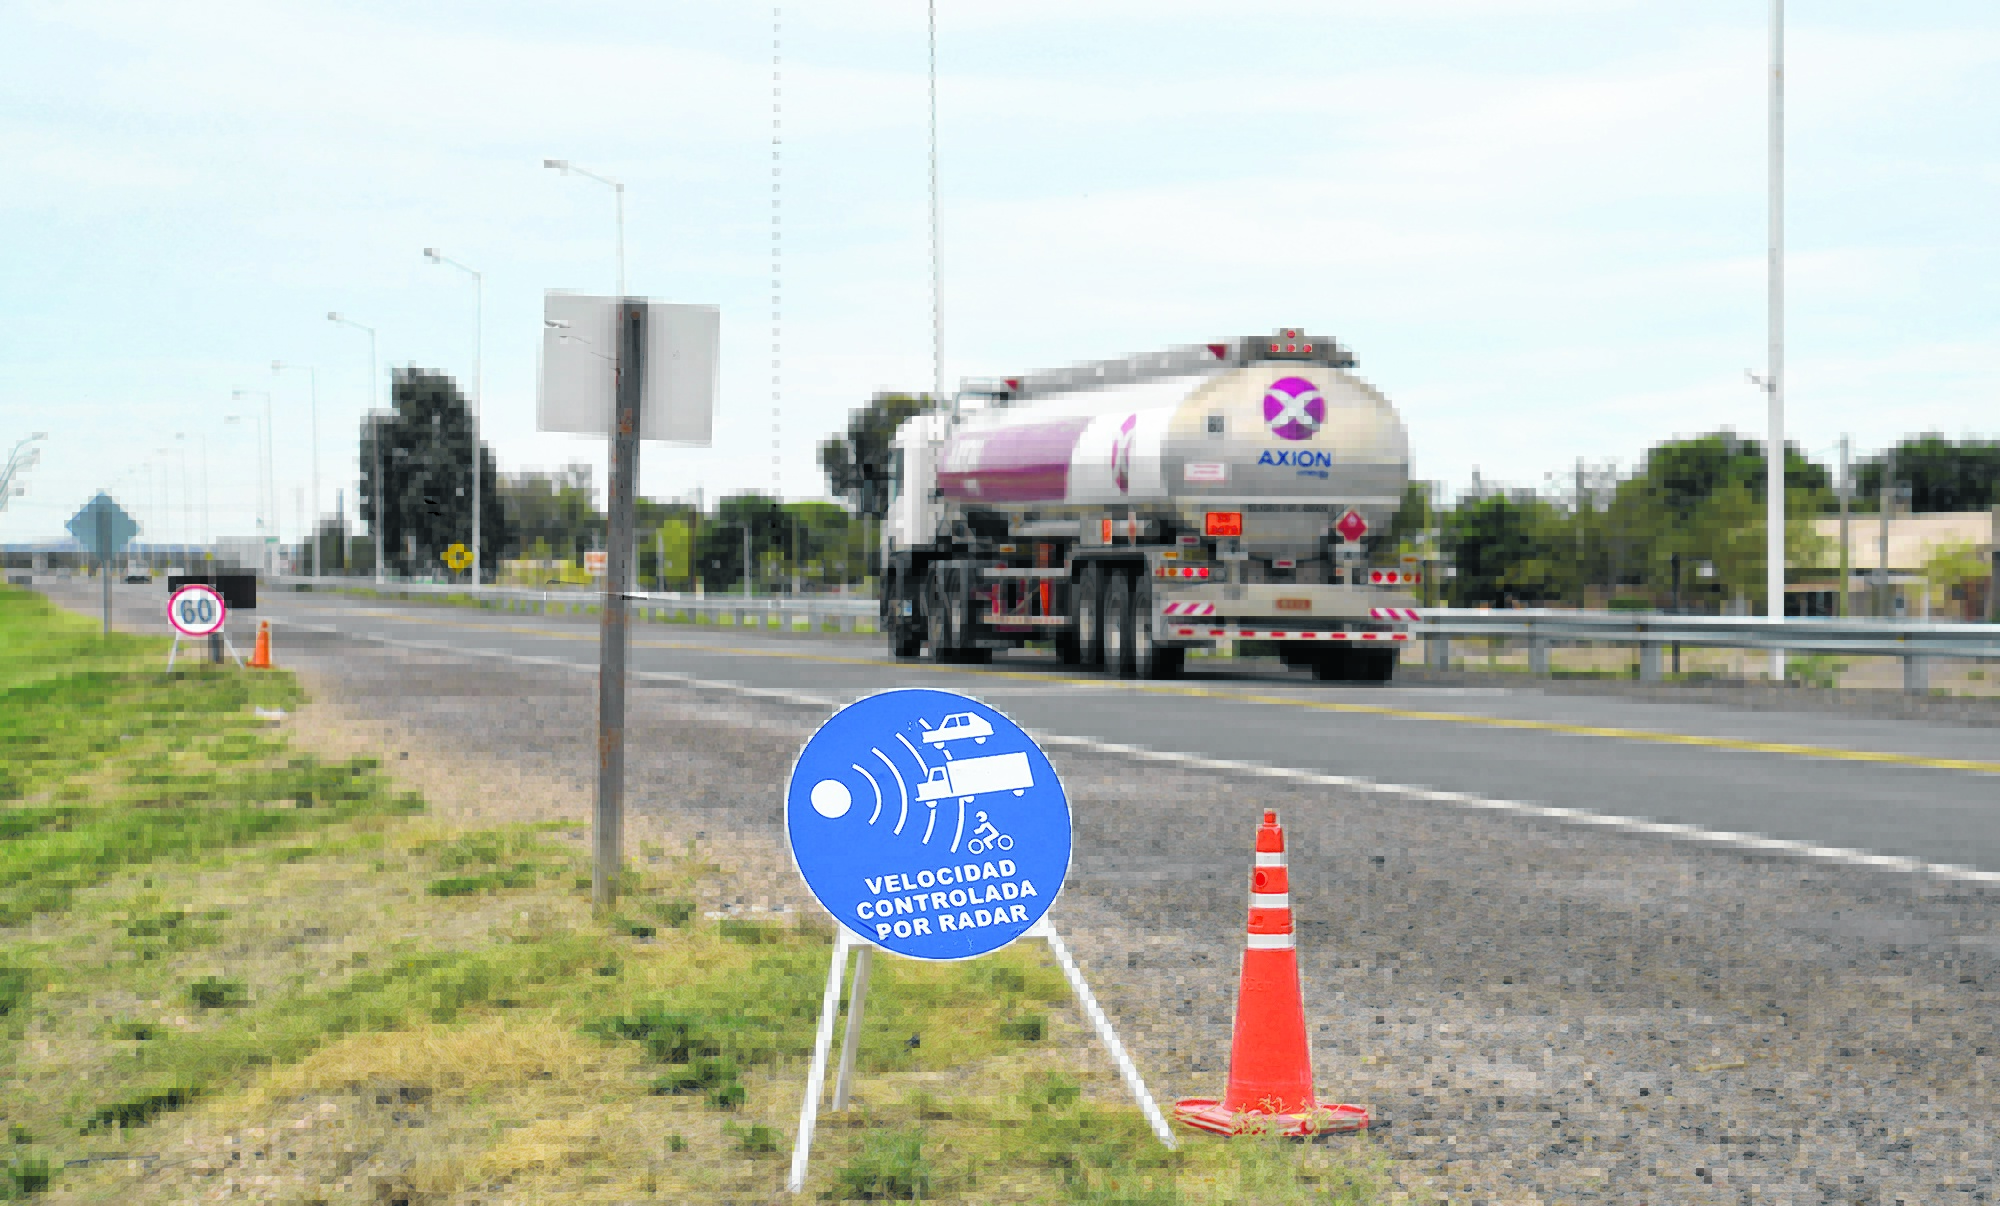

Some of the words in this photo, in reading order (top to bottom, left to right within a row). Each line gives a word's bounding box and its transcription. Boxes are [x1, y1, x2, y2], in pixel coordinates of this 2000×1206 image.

[1257, 450, 1332, 467] AXION
[180, 599, 212, 625] 60
[865, 859, 1016, 894] VELOCIDAD
[857, 879, 1037, 919] CONTROLADA
[876, 917, 932, 940] POR
[939, 904, 1029, 932] RADAR
